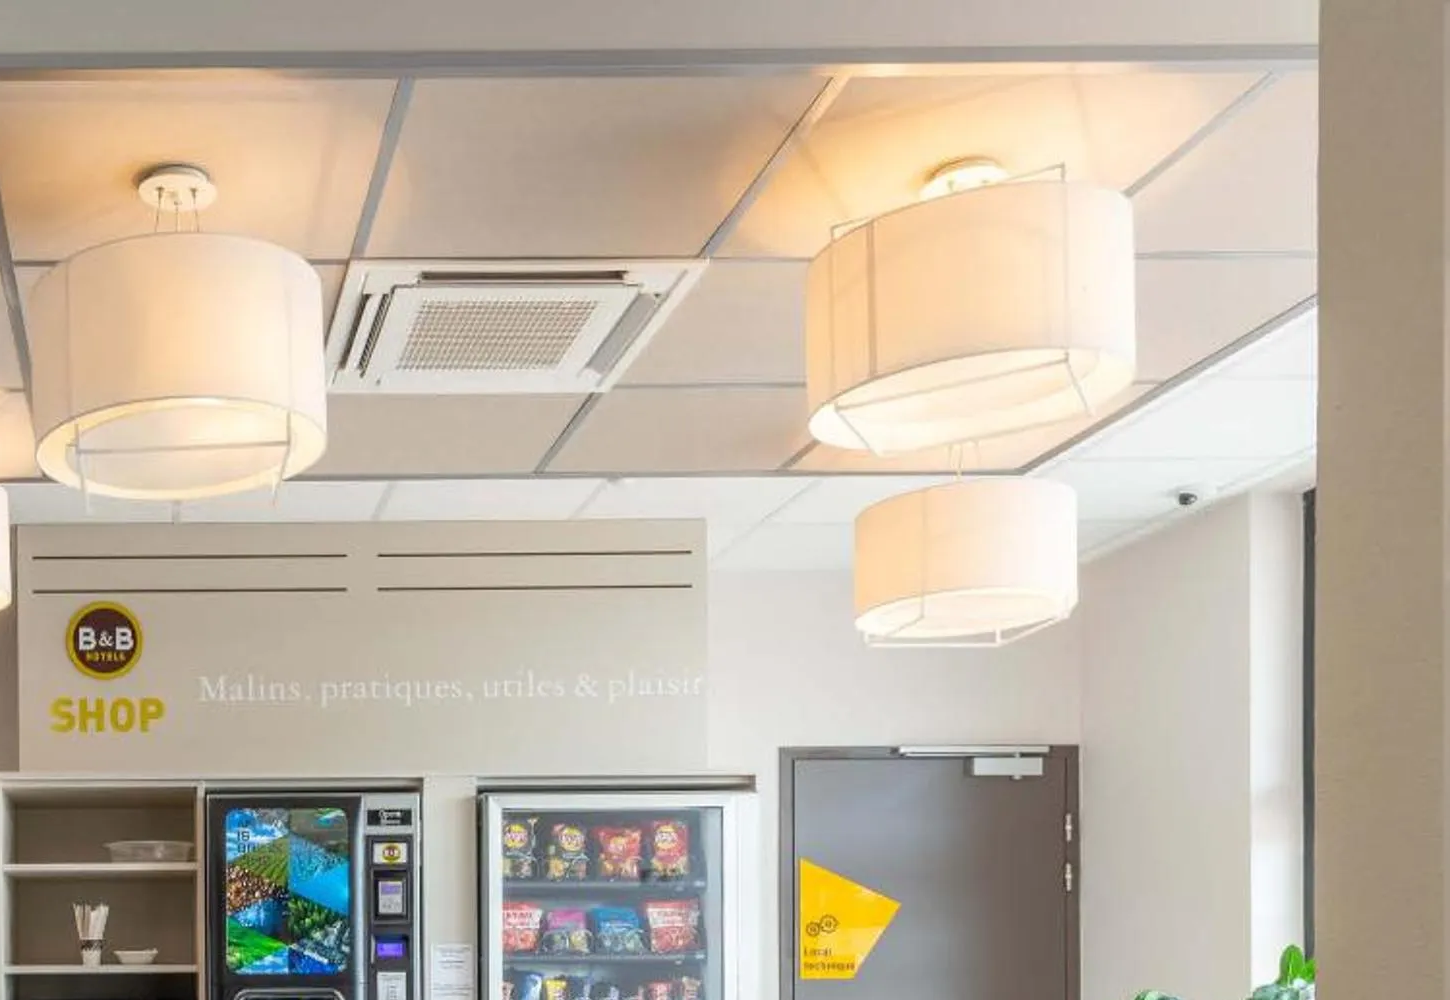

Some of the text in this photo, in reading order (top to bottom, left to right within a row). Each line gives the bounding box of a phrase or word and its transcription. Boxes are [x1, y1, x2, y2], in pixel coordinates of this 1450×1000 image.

[78, 626, 134, 650] B&B
[483, 667, 565, 698] utiles
[574, 672, 598, 698] &
[49, 696, 165, 733] SHOP
[803, 947, 832, 957] Local
